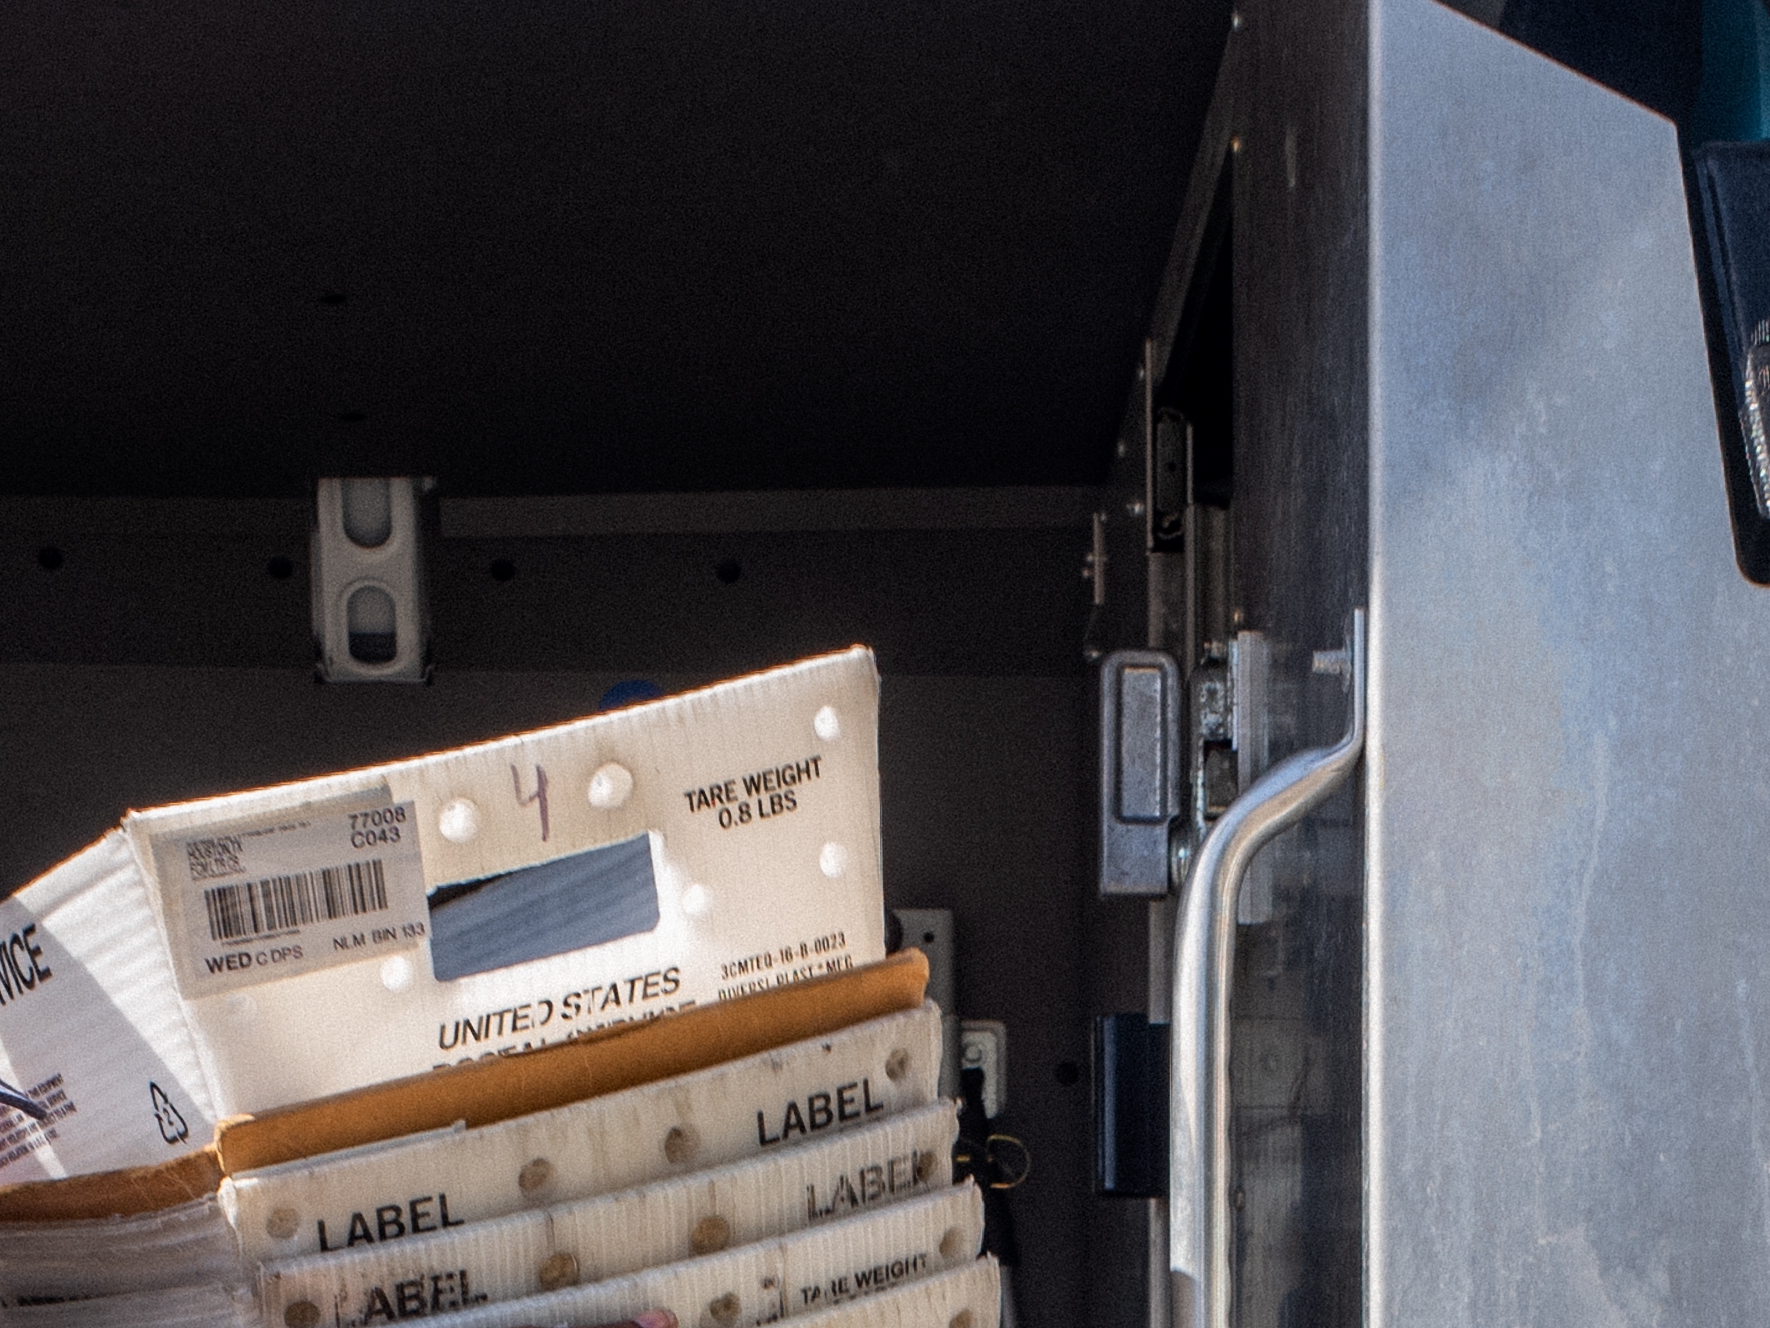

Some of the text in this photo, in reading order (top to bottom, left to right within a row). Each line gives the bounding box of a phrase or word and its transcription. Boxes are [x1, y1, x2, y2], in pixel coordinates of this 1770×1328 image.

[683, 755, 823, 814] TARE WEIGHT
[717, 791, 798, 830] 0.8 LBS
[348, 805, 407, 832] 77008
[203, 951, 252, 975] WED
[271, 945, 304, 964] DPS
[438, 1000, 552, 1050] UNITED
[561, 966, 680, 1017] STATES
[757, 1078, 883, 1147] LABEL
[806, 1150, 931, 1221] LABEL
[317, 1192, 465, 1253] LABEL
